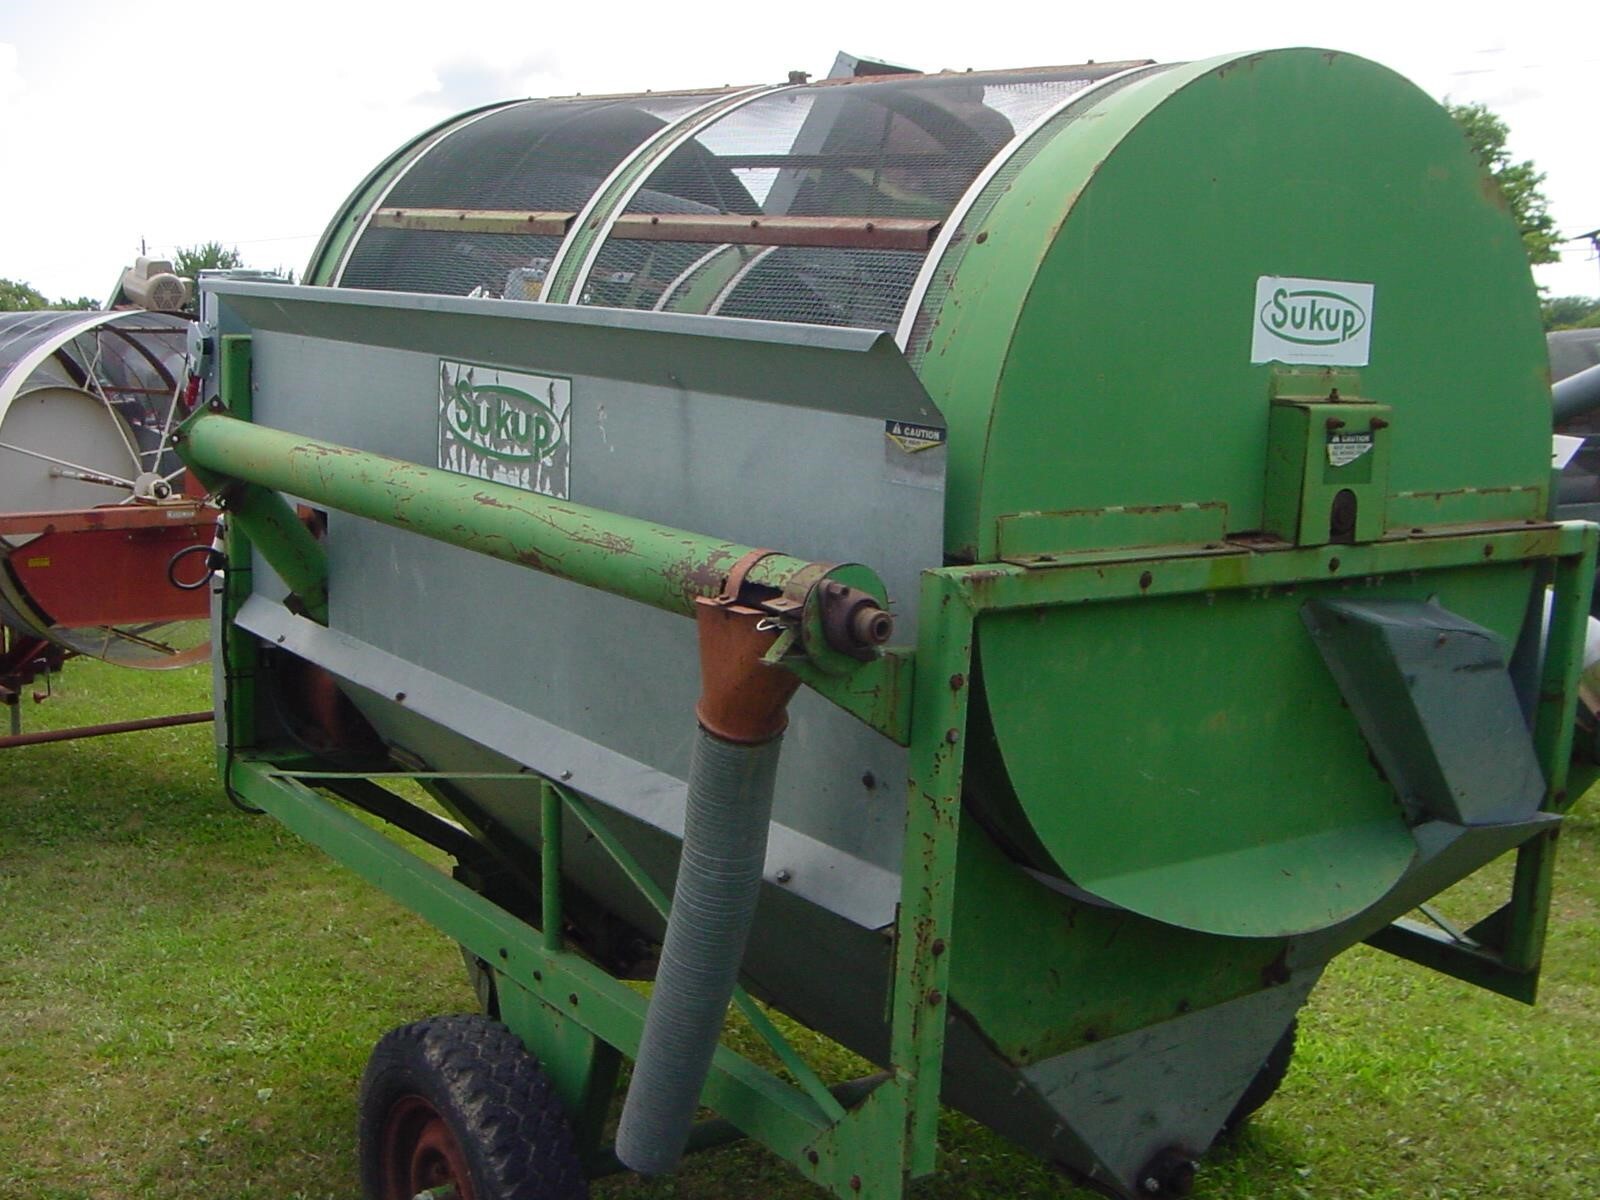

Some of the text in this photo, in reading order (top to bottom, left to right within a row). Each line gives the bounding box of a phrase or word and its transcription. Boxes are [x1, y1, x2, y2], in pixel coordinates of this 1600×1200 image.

[1271, 288, 1355, 341] Sukup
[455, 380, 549, 461] Sukup
[904, 427, 940, 440] CAUTION
[1341, 435, 1370, 443] CAUTION
